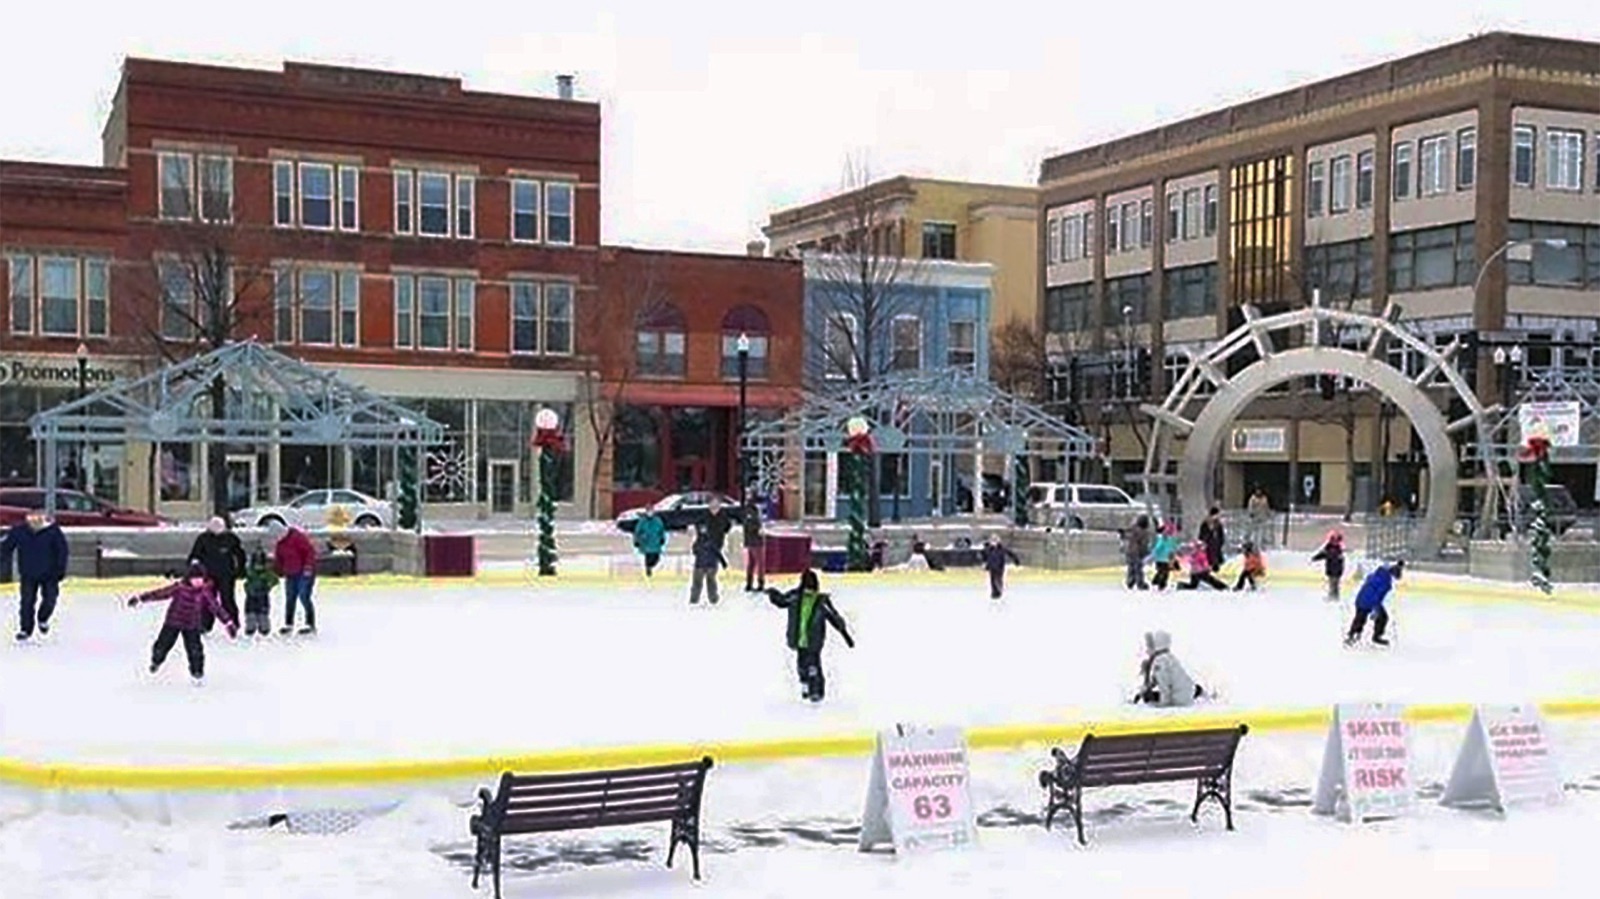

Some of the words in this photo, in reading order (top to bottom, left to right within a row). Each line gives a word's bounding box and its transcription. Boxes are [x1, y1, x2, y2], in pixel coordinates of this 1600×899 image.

[12, 361, 115, 381] Promotons
[1346, 721, 1402, 737] SKATE
[887, 752, 964, 768] MAXIMUM
[892, 774, 964, 790] CAPACITY
[1355, 767, 1406, 788] RISK
[914, 795, 952, 819] 63
